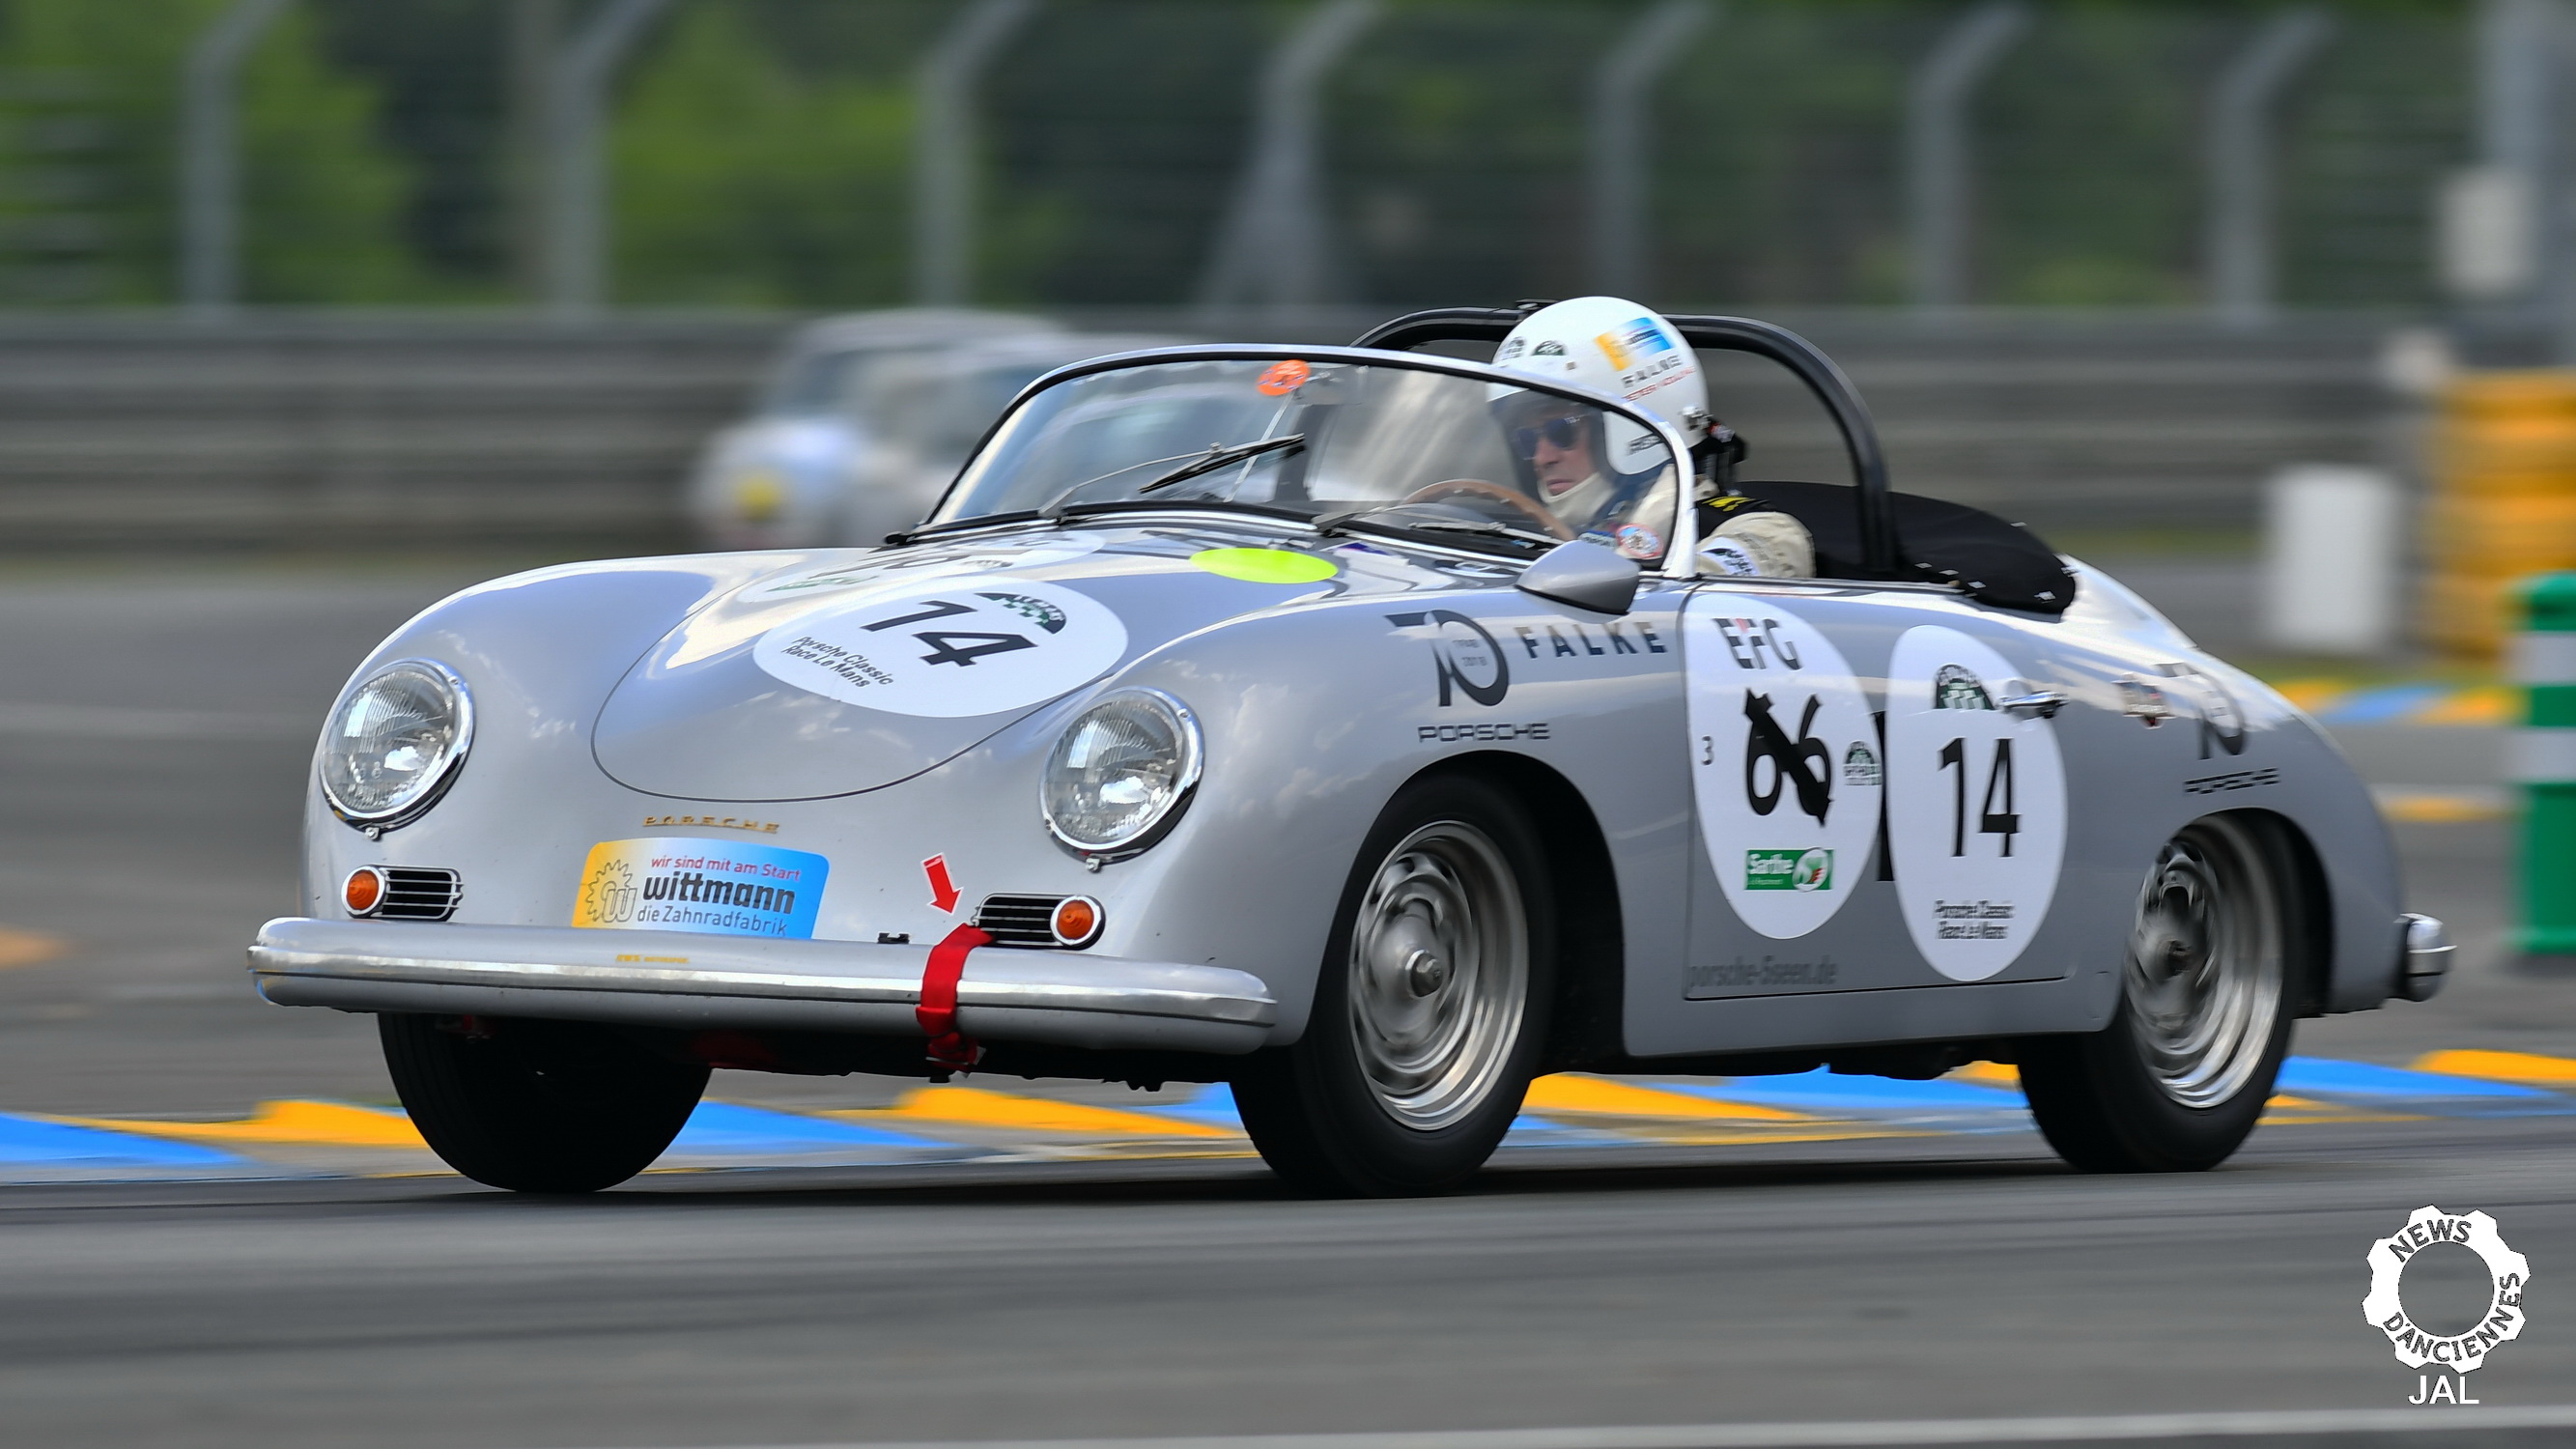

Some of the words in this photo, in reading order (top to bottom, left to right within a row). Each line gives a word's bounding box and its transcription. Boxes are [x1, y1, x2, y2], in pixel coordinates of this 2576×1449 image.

[860, 599, 1038, 667] 14
[1514, 621, 1668, 659] FALKE
[1713, 617, 1801, 670] EFG
[1418, 723, 1550, 743] PORSCHE
[1939, 737, 2022, 858] 14
[644, 815, 779, 834] PORSCHE
[651, 855, 672, 868] wir
[675, 855, 704, 869] sind
[706, 860, 731, 871] mit
[734, 863, 758, 874] am
[761, 864, 801, 882] Start
[642, 870, 795, 915] wittmann
[637, 905, 660, 923] die
[662, 905, 788, 936] Zahnradfabrik
